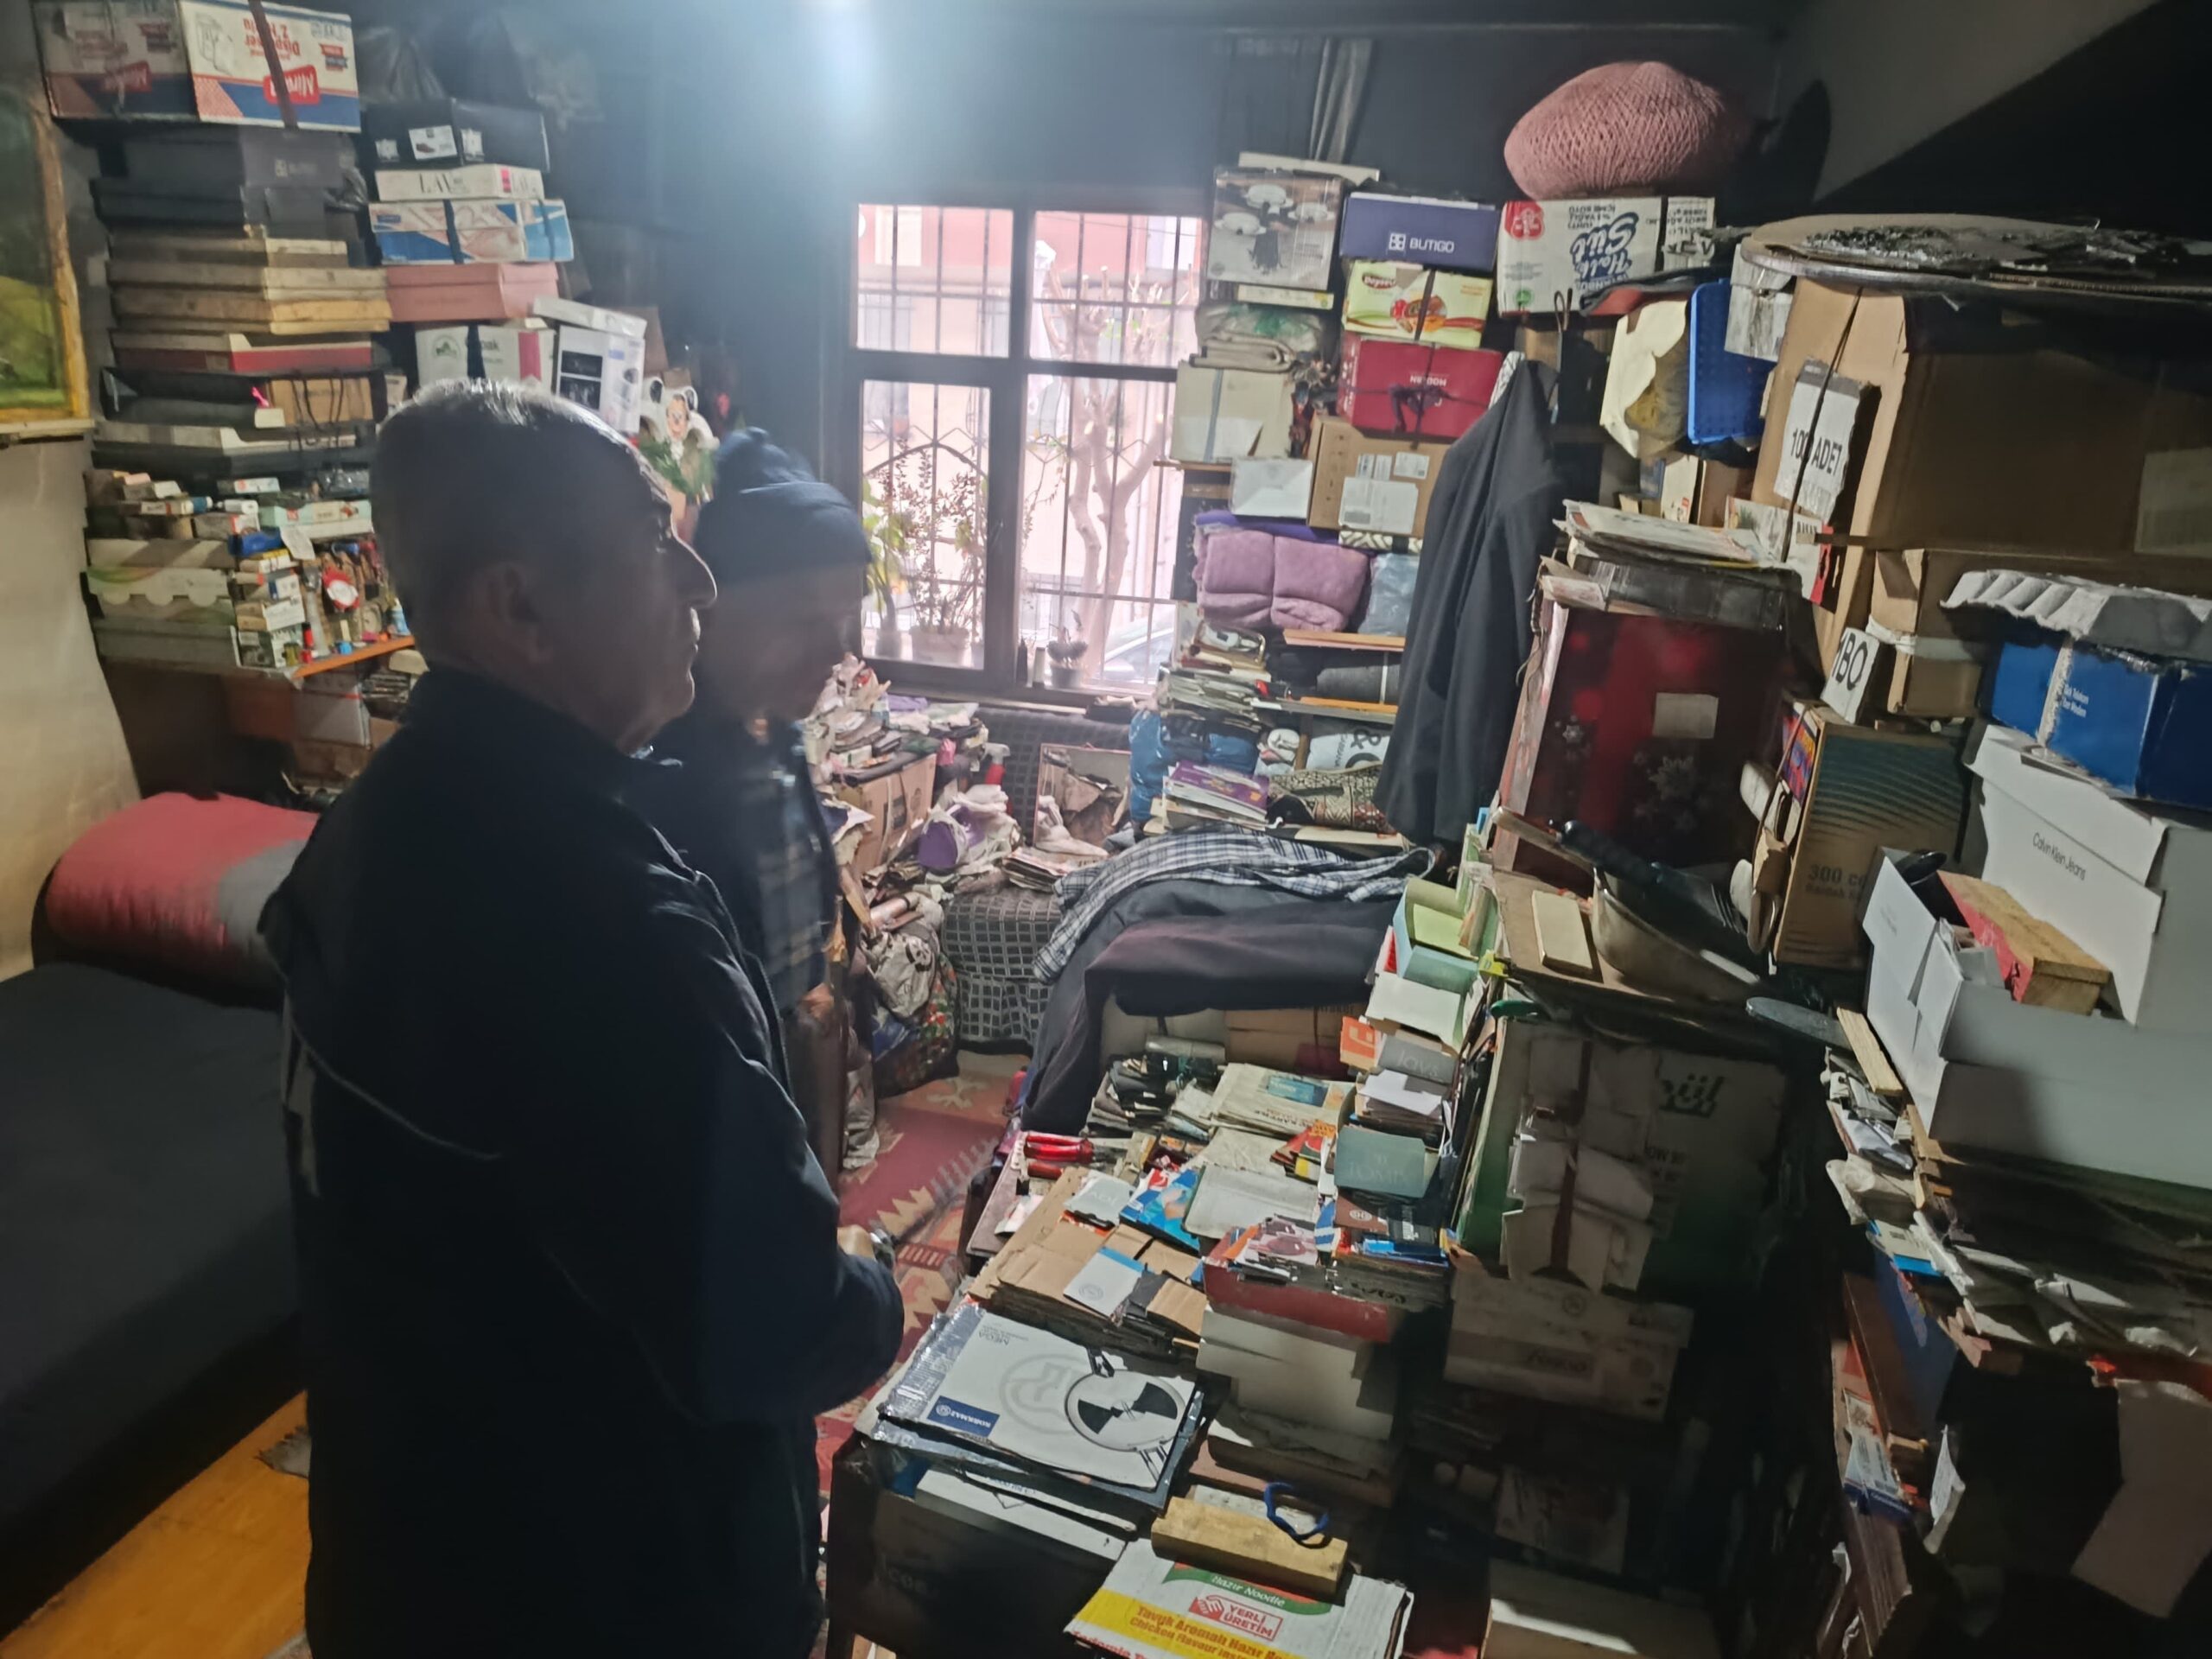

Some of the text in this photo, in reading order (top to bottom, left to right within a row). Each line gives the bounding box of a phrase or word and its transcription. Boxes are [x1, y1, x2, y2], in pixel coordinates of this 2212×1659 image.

[1408, 237, 1455, 253] BUTIGO
[1571, 213, 1637, 264] Süt
[1575, 249, 1631, 278] Halk
[1811, 436, 1843, 476] ADET
[1244, 1586, 1286, 1607] Noodle
[1224, 1612, 1274, 1637] ÜRETİM
[1230, 1604, 1267, 1623] YERLİ
[1130, 1617, 1175, 1639] Chicken
[1137, 1606, 1174, 1627] Tavuk
[1175, 1620, 1227, 1645] Aromalı
[1229, 1637, 1263, 1658] Hazır
